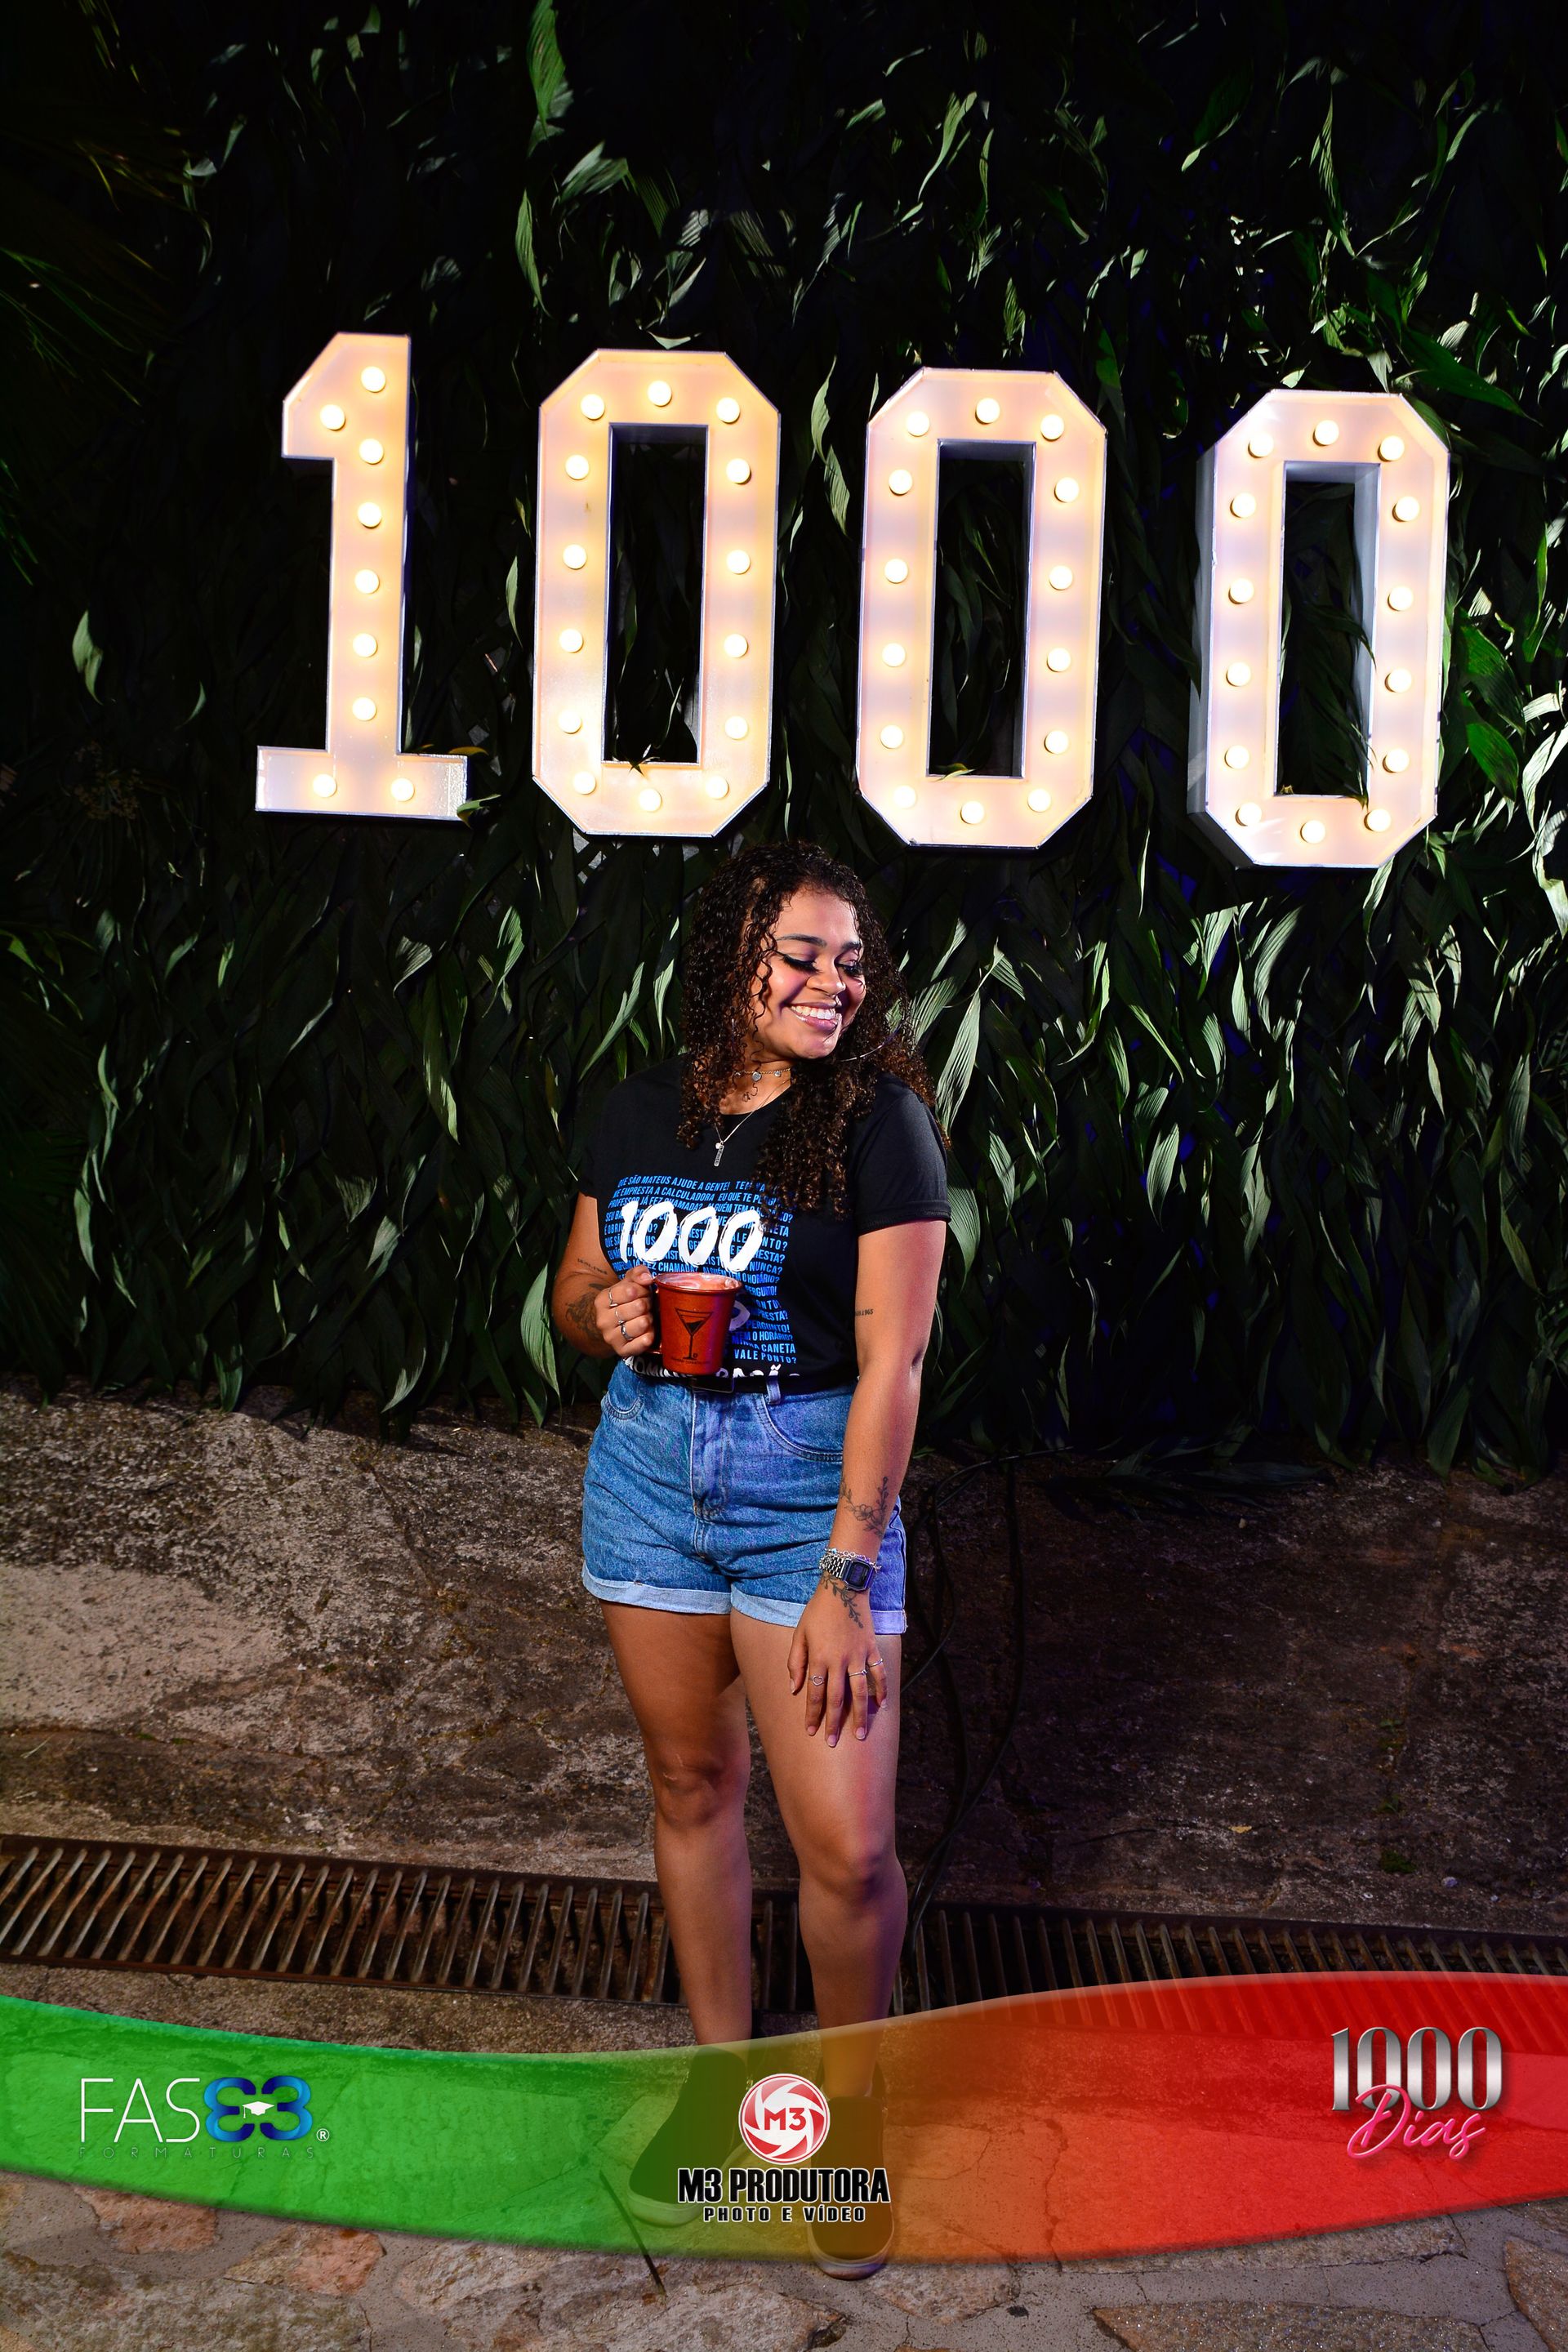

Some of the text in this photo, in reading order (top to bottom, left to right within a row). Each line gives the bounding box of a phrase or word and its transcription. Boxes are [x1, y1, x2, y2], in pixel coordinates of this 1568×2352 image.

[628, 1174, 641, 1185] SÃO
[641, 1176, 671, 1185] MATEUS
[671, 1177, 698, 1191] AJUDE
[697, 1182, 704, 1190] A
[705, 1182, 731, 1192] GENTE!
[621, 1187, 653, 1196] EMPRESTA
[654, 1187, 661, 1195] A
[661, 1187, 715, 1202] CALCULADORA
[718, 1192, 728, 1201] EU
[727, 1192, 741, 1201] QUE
[742, 1193, 753, 1203] TE
[639, 1195, 649, 1205] JÁ
[620, 1200, 764, 1274] 1000
[749, 1262, 783, 1276] NUNCA?
[746, 1320, 791, 1334] PERGUNTO!
[752, 1331, 758, 1342] O
[759, 1331, 794, 1342] HORÁRIO?
[761, 1343, 796, 1354] CANETA
[734, 1349, 797, 1365] VALE PONTO?
